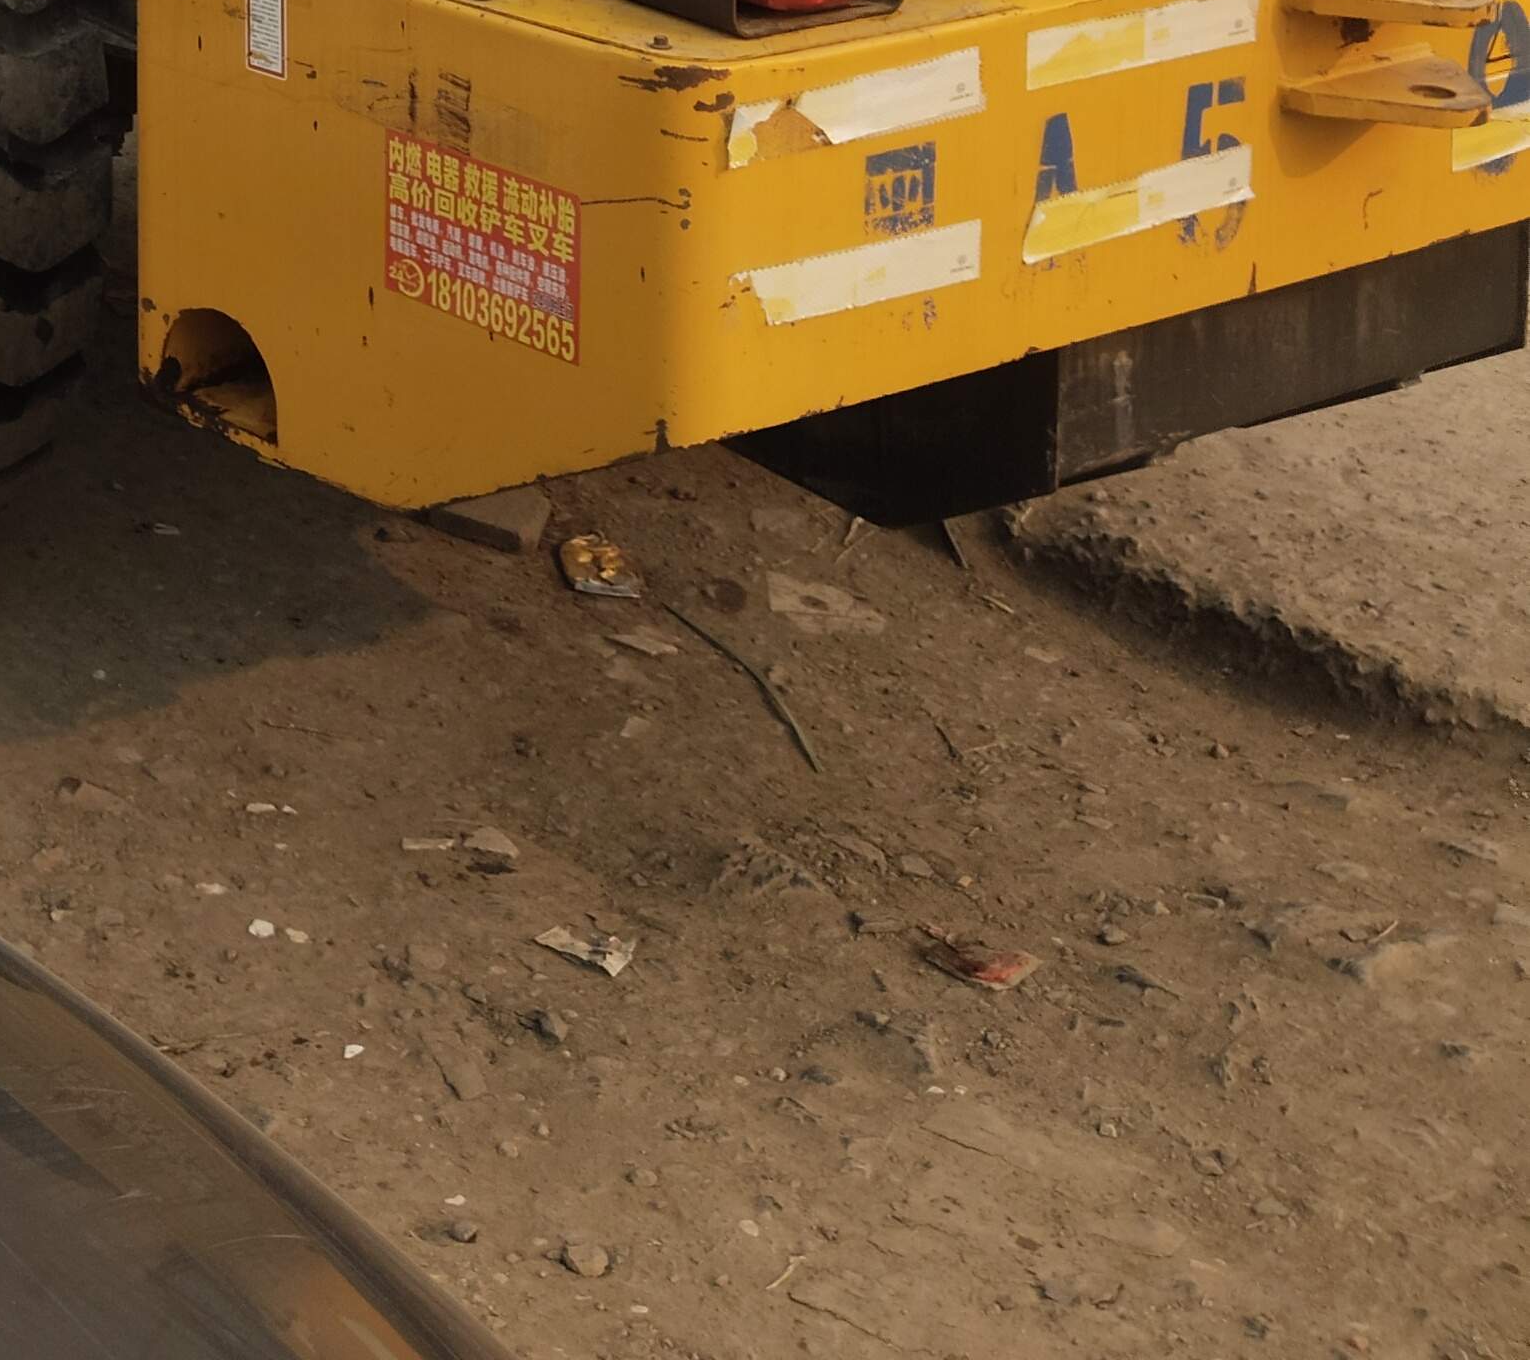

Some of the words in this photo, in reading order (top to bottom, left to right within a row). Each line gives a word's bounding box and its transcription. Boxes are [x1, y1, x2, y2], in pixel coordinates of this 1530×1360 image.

[388, 171, 575, 264] 高价回收铲车叉车
[426, 149, 460, 193] 电器
[503, 176, 576, 235] 流动补胎
[427, 268, 575, 361] 18103692565
